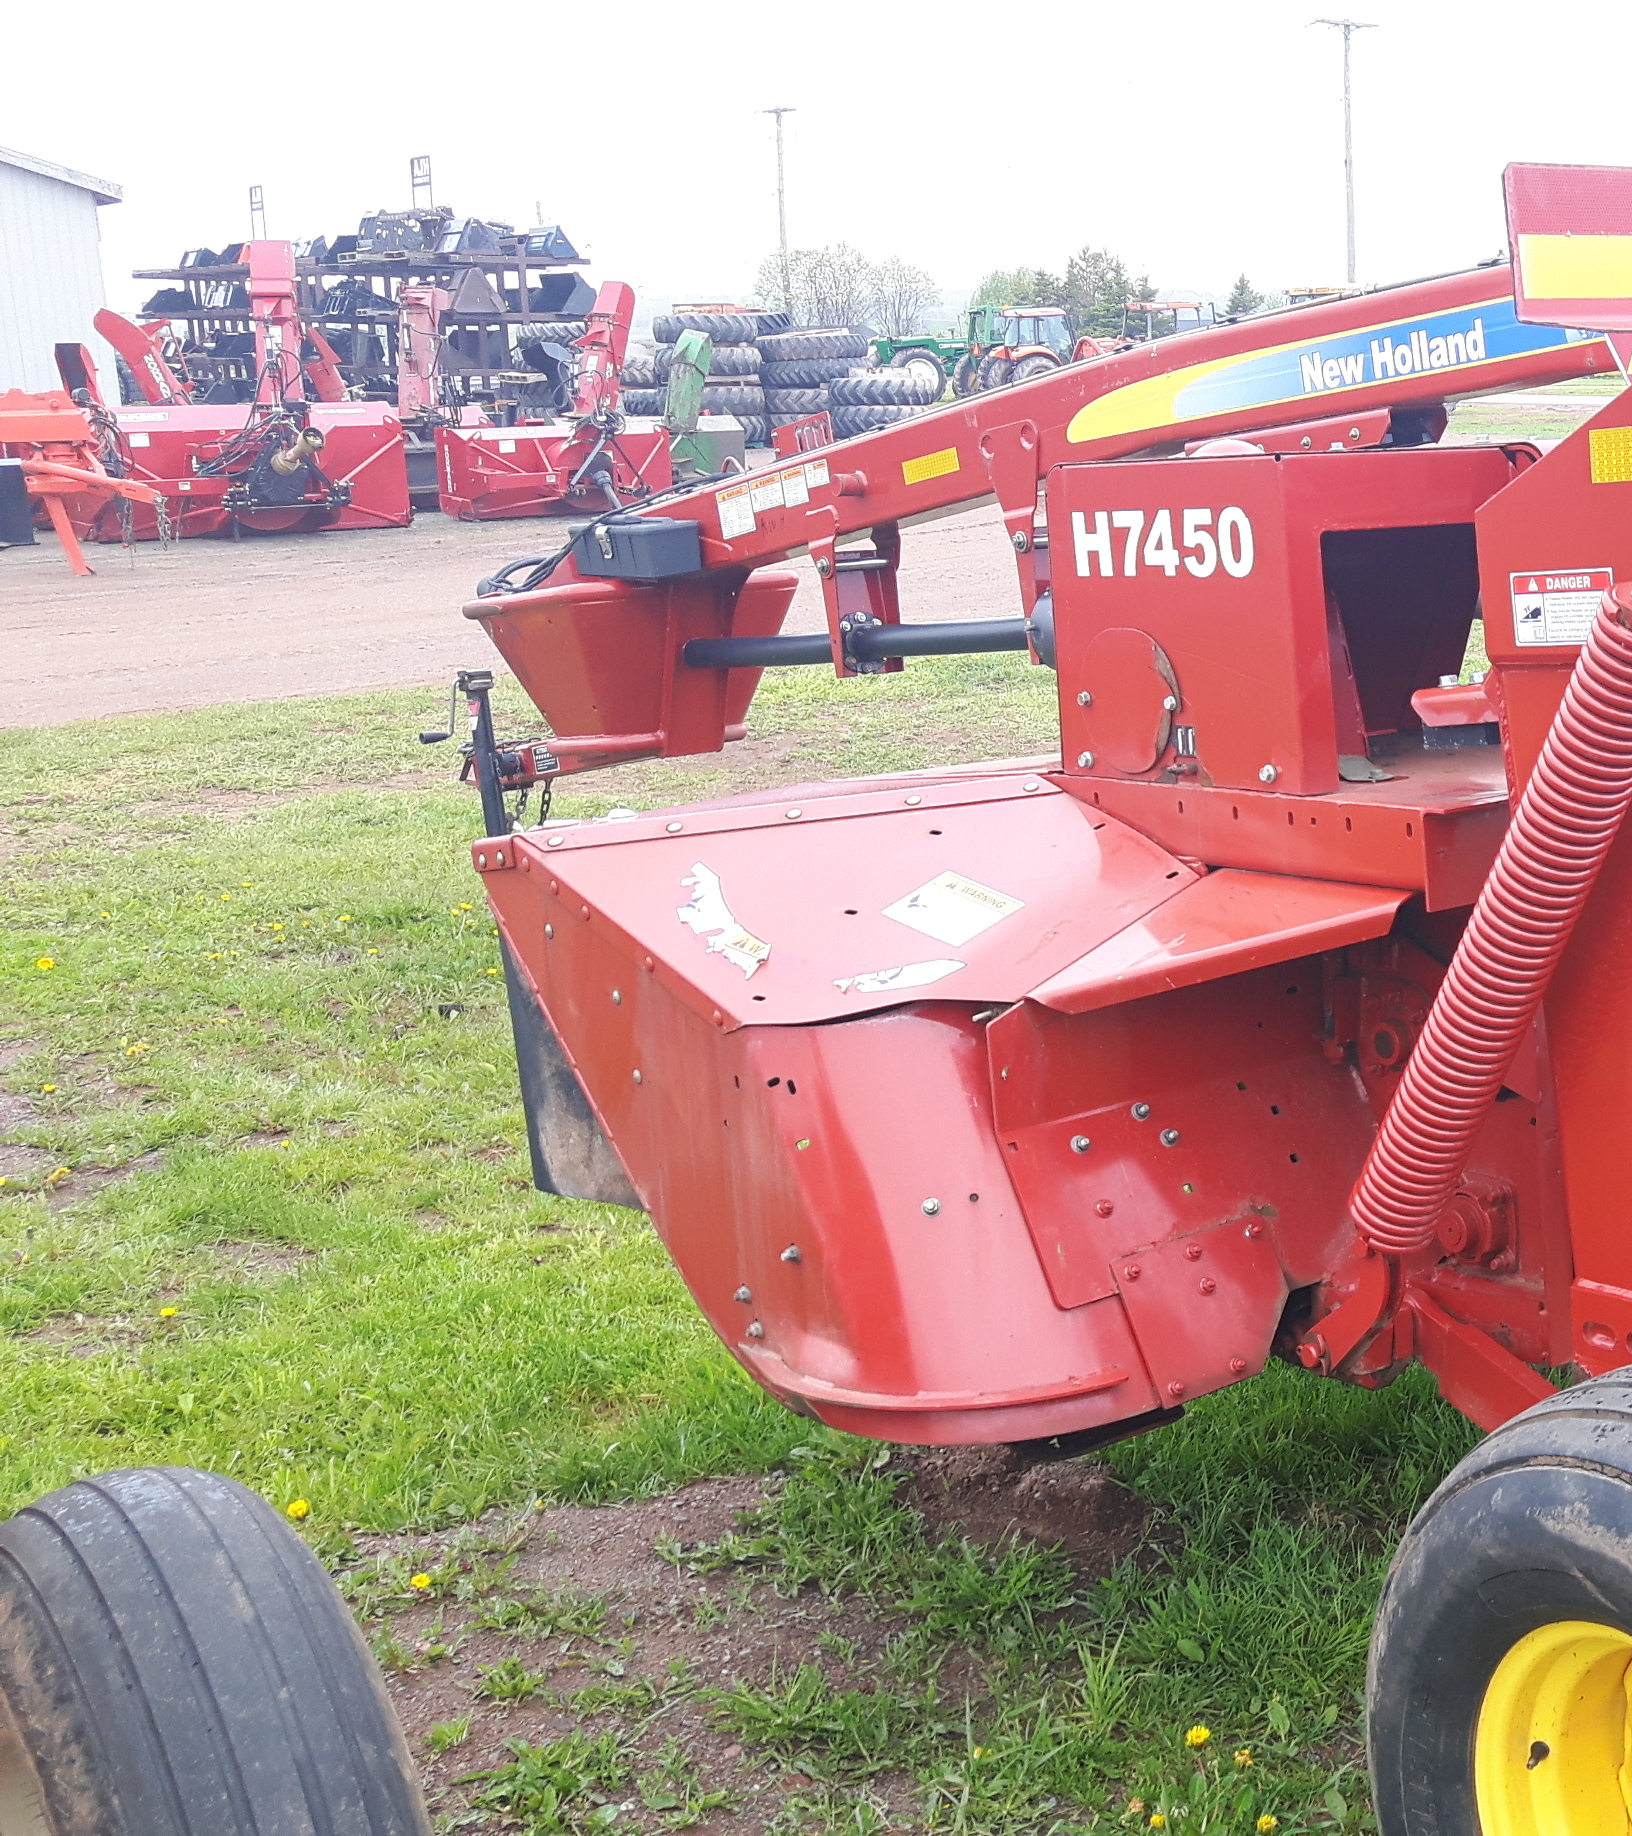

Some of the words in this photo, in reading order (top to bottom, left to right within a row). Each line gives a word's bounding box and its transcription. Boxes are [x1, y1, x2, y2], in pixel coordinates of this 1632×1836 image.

[1299, 350, 1365, 393] New
[1369, 317, 1487, 379] Holland
[1070, 505, 1255, 578] H7450
[1546, 575, 1591, 590] DANGER
[960, 886, 1007, 909] WARNING
